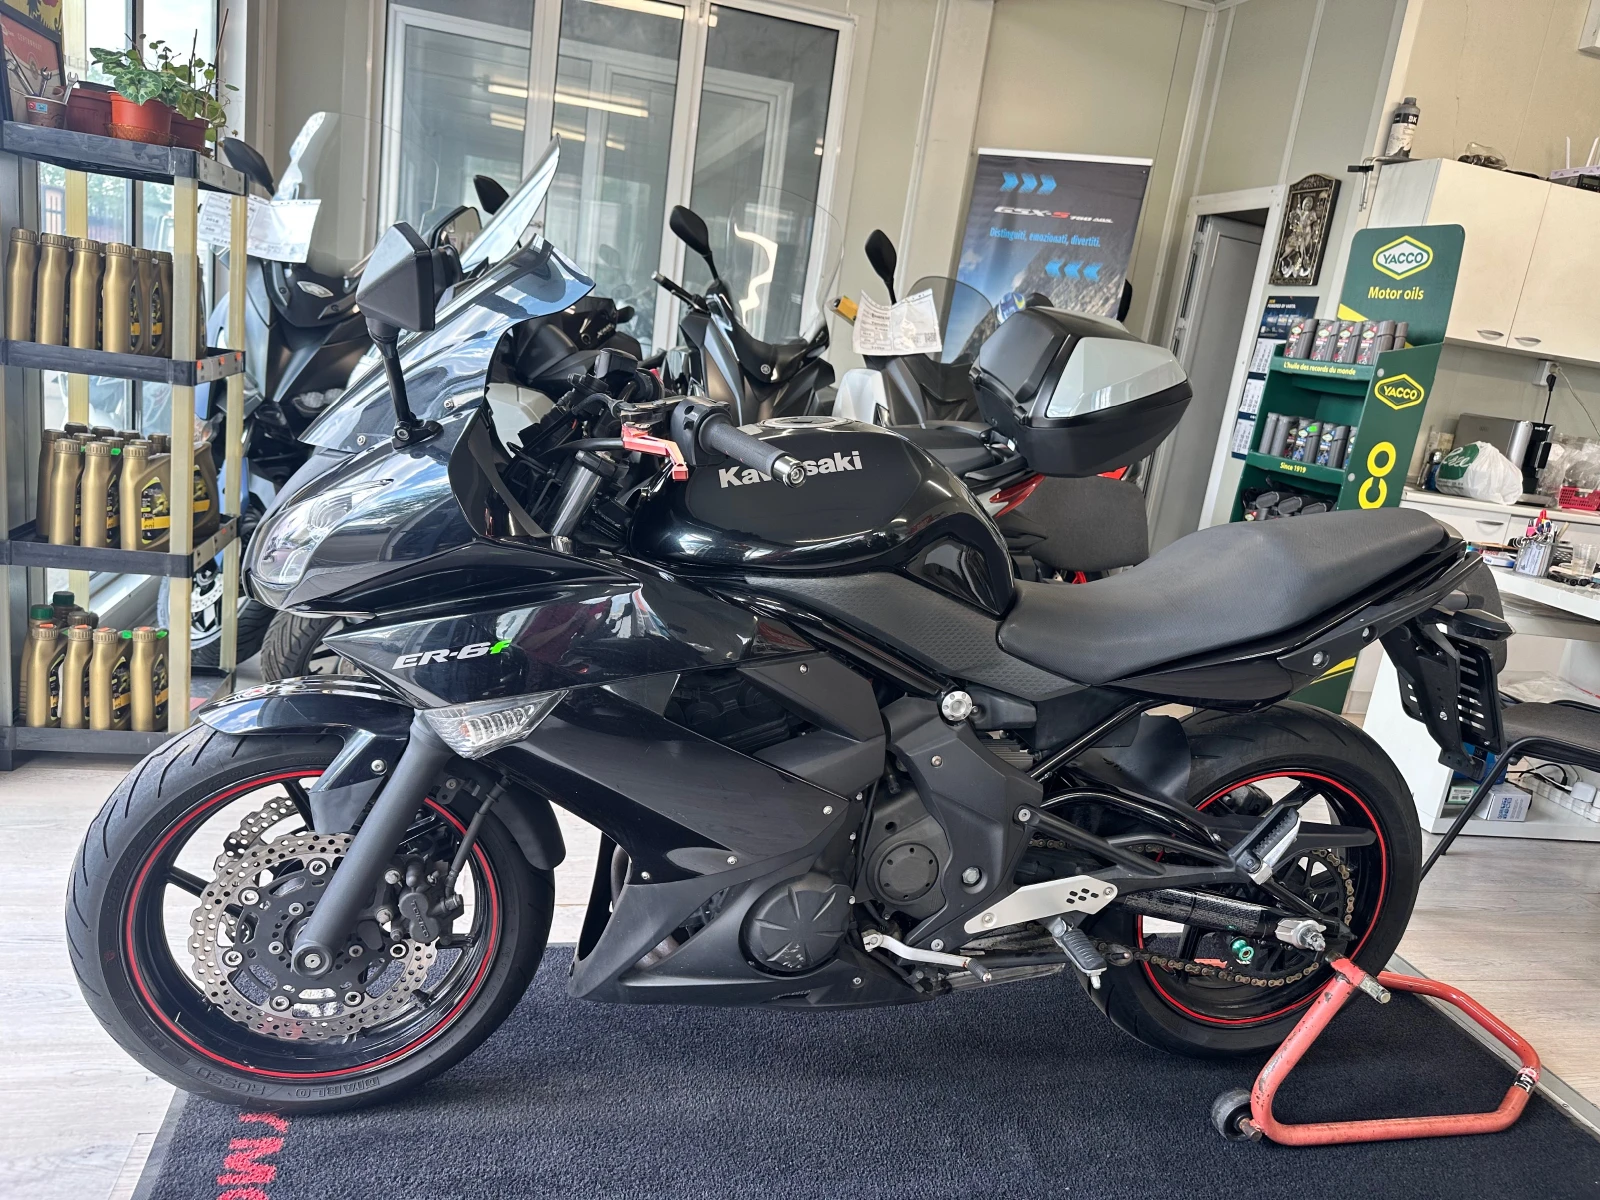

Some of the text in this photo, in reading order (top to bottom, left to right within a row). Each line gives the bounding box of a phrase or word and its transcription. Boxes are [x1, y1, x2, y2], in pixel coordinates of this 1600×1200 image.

[990, 227, 1100, 248] Distinguiti, emozionati, divertiti.
[1383, 252, 1424, 265] YACCO
[1368, 286, 1424, 300] Motor oils
[1300, 363, 1310, 371] des
[1310, 365, 1328, 373] records
[1329, 366, 1336, 374] du
[1337, 367, 1356, 376] monde
[1383, 385, 1418, 400] YACCO
[1279, 461, 1307, 474] Since 1919
[392, 639, 513, 670] ER-6f
[411, 899, 430, 938] TOKICO
[196, 1066, 380, 1099] DIABLO ROSSO
